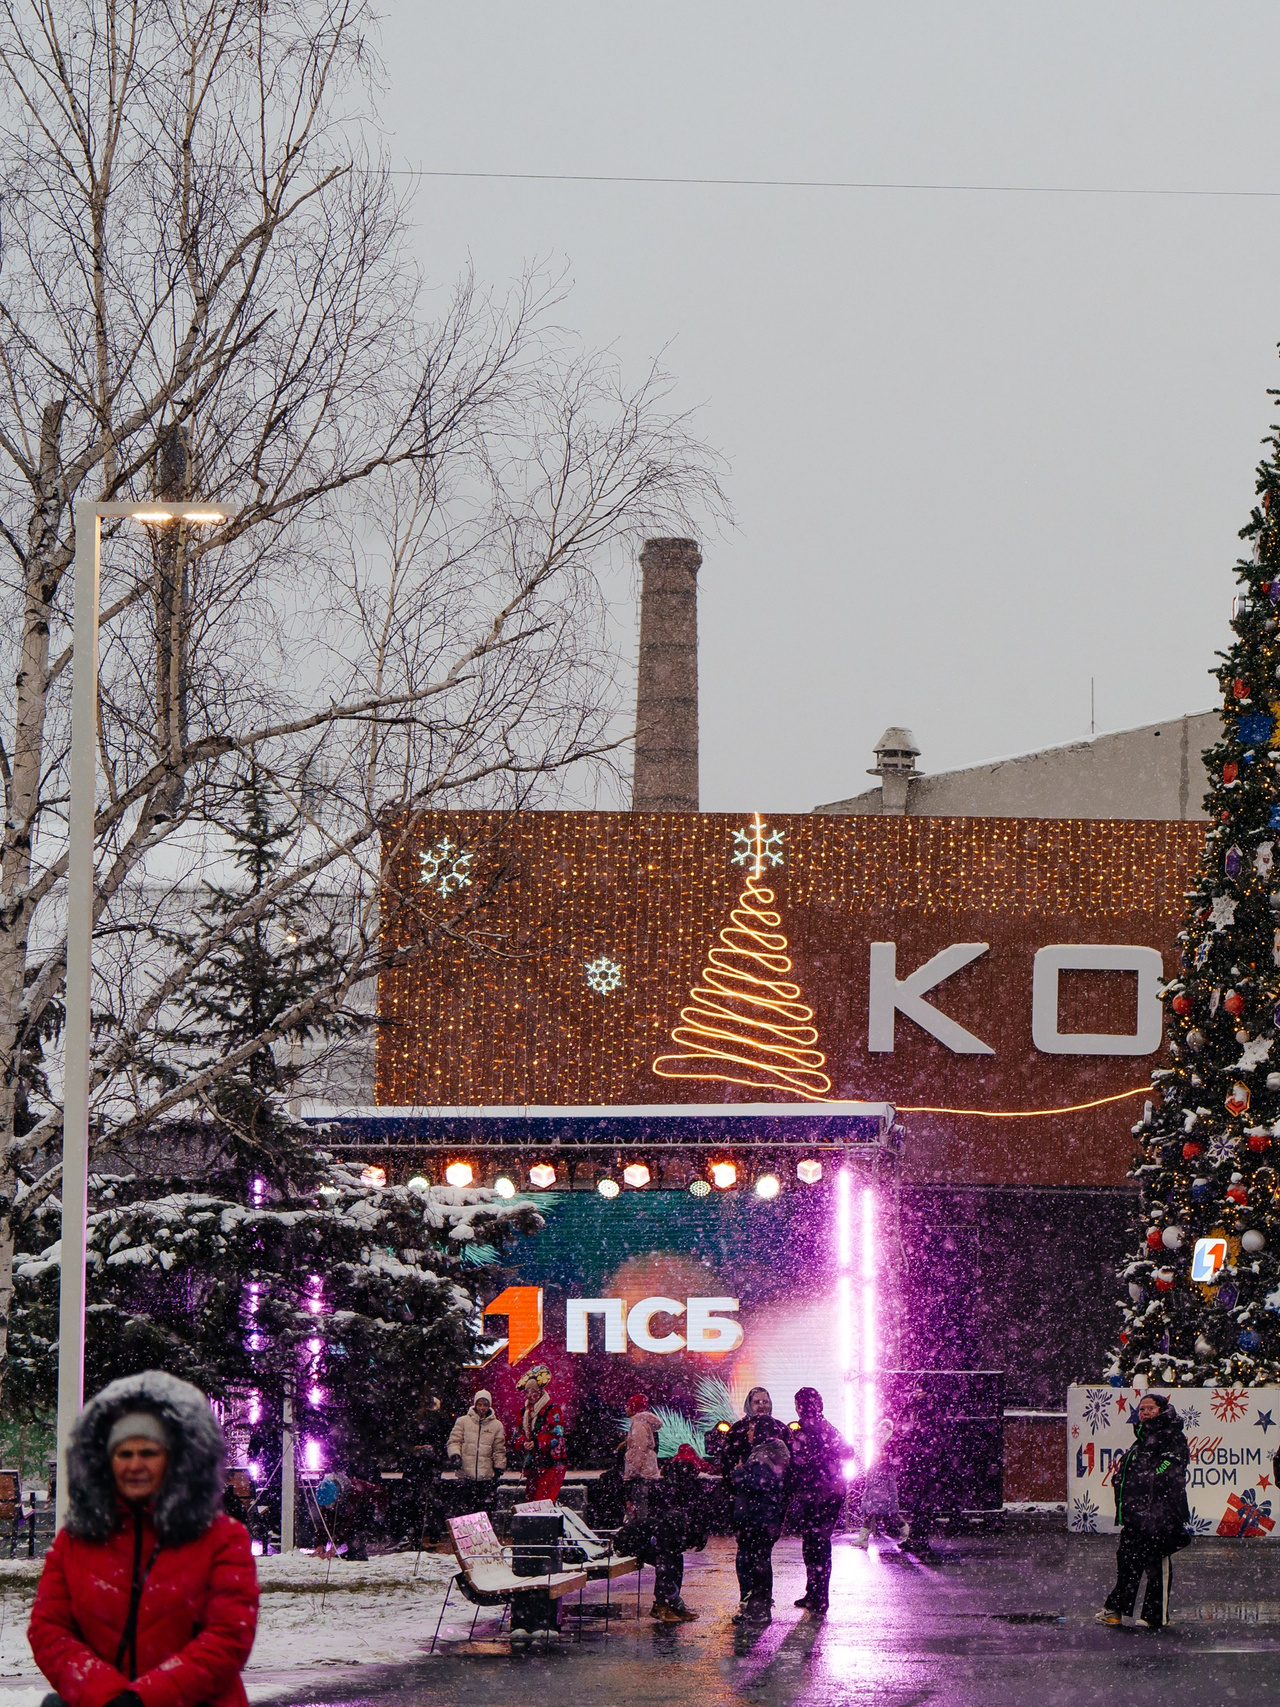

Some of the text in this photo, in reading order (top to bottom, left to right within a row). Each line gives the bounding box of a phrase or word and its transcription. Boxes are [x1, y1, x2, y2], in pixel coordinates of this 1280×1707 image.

[566, 1296, 744, 1354] ПСБ
[1099, 1448, 1129, 1473] ПС
[1187, 1447, 1261, 1465] НОВЫМ
